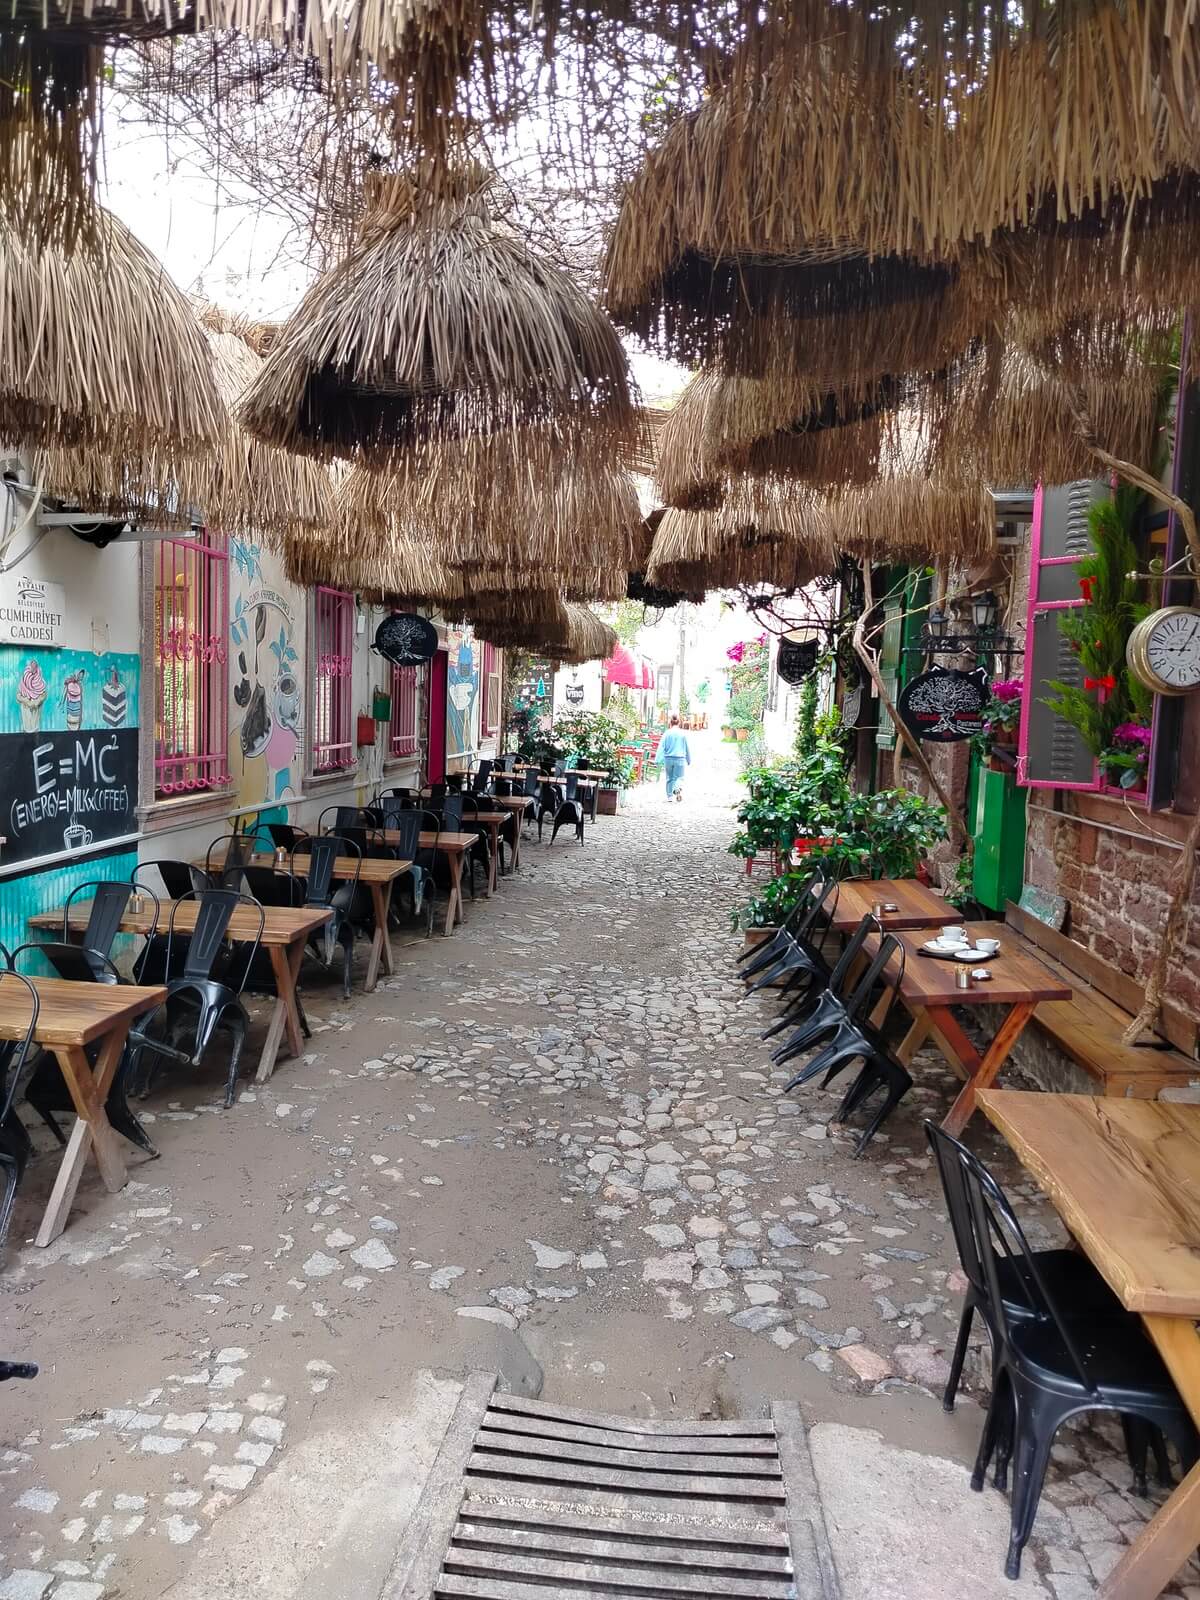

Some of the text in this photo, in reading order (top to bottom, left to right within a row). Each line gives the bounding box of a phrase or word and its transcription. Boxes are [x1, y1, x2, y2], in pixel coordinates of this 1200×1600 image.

[0, 608, 62, 626] CUMHURİYET
[1176, 616, 1188, 632] 12
[10, 625, 54, 641] CADDESİ
